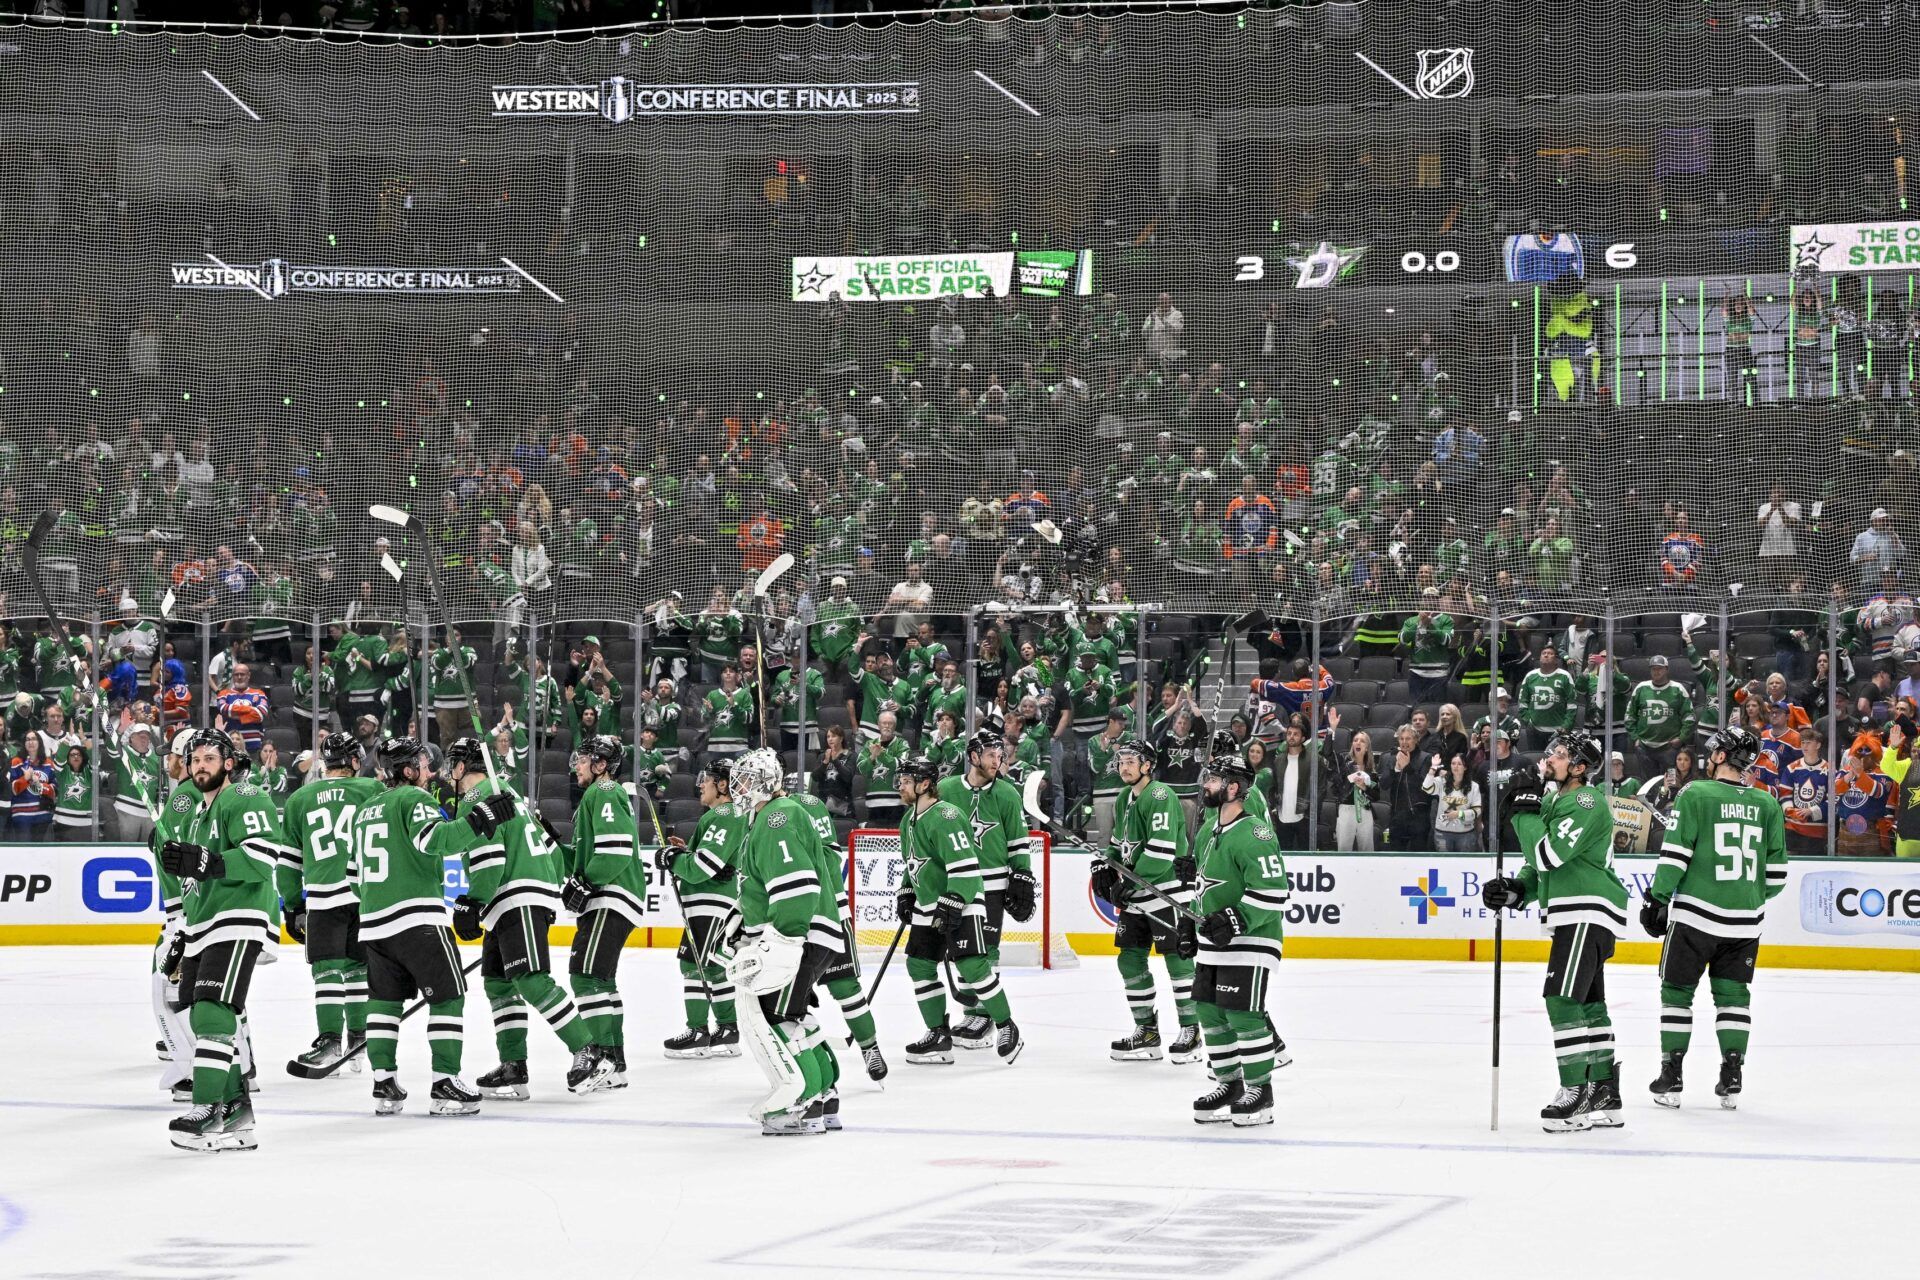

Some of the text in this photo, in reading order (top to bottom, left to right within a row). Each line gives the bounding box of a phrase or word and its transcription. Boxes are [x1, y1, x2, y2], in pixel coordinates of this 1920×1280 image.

[1430, 57, 1463, 91] NHL
[492, 88, 898, 110] WESTERN CONFERENCE FINAL 2025
[1857, 228, 1899, 243] THE
[1401, 250, 1460, 272] 0.0
[1605, 243, 1637, 268] 6
[1848, 245, 1920, 265] STAR
[172, 267, 503, 289] WESTERN CONFERENCE FINAL 2025
[854, 259, 984, 277] THE OFFICIAL
[1235, 256, 1264, 281] 3
[846, 274, 993, 297] STARS APP
[1554, 679, 1562, 688] C
[1262, 704, 1274, 713] 97
[316, 788, 345, 805] HINTZ
[1801, 788, 1813, 796] 29
[242, 810, 273, 835] 91
[601, 802, 614, 823] 4
[1151, 812, 1170, 831] 21
[1617, 811, 1638, 821] WIN
[1720, 803, 1760, 822] HARLEY
[208, 819, 220, 840] A
[306, 804, 357, 862] 24
[702, 824, 727, 846] 64
[948, 830, 971, 851] 18
[1557, 817, 1584, 849] 44
[778, 840, 794, 864] 1
[1713, 822, 1763, 883] 55
[1257, 855, 1283, 879] 15
[1, 874, 52, 902] PP
[82, 857, 165, 913] G
[1287, 865, 1336, 893] sub
[1225, 907, 1241, 935] CCM
[1285, 907, 1341, 925] ove
[1463, 908, 1543, 919] HELT
[1215, 984, 1240, 994] CCM
[768, 1027, 795, 1075] TRUE
